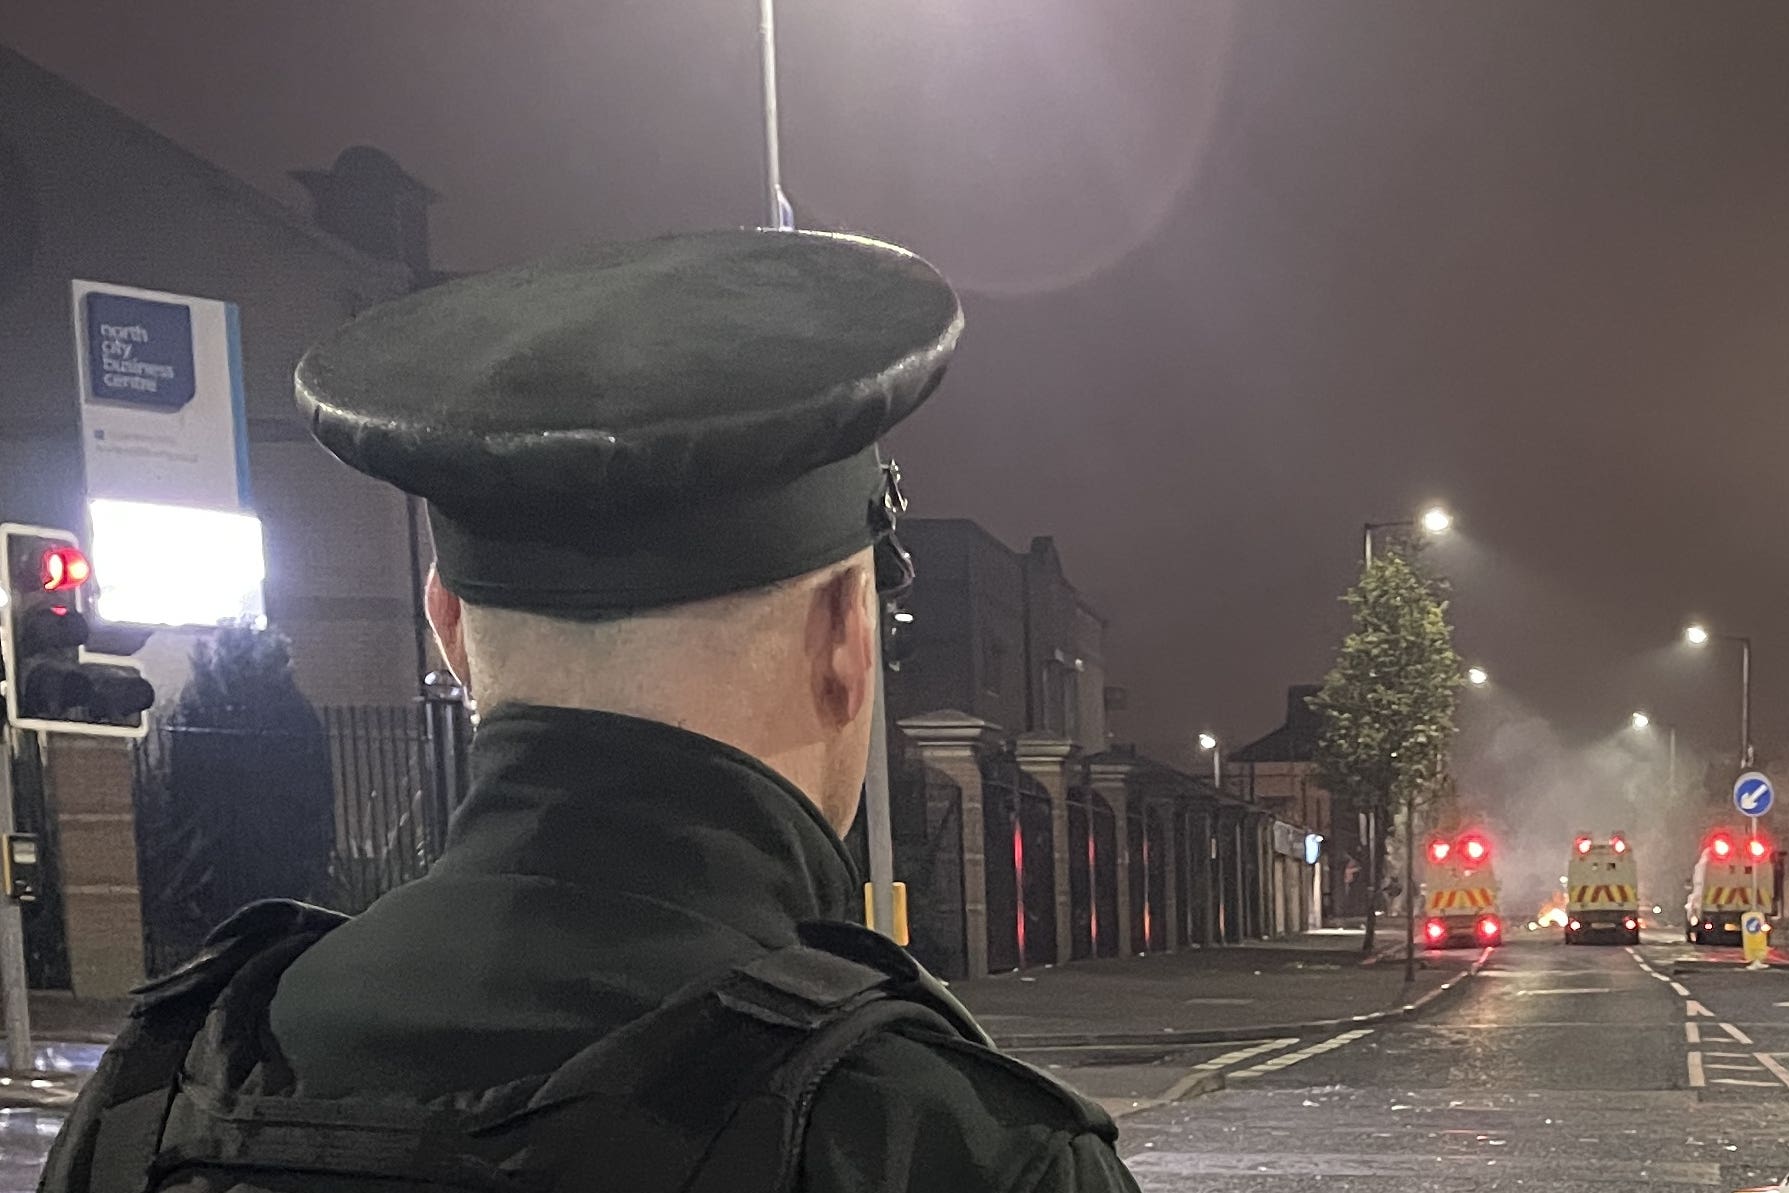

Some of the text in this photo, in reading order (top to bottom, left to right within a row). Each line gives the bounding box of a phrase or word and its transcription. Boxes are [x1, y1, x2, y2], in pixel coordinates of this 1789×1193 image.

[101, 324, 148, 342] north
[102, 340, 132, 359] city
[103, 358, 174, 379] business
[103, 373, 158, 392] centre
